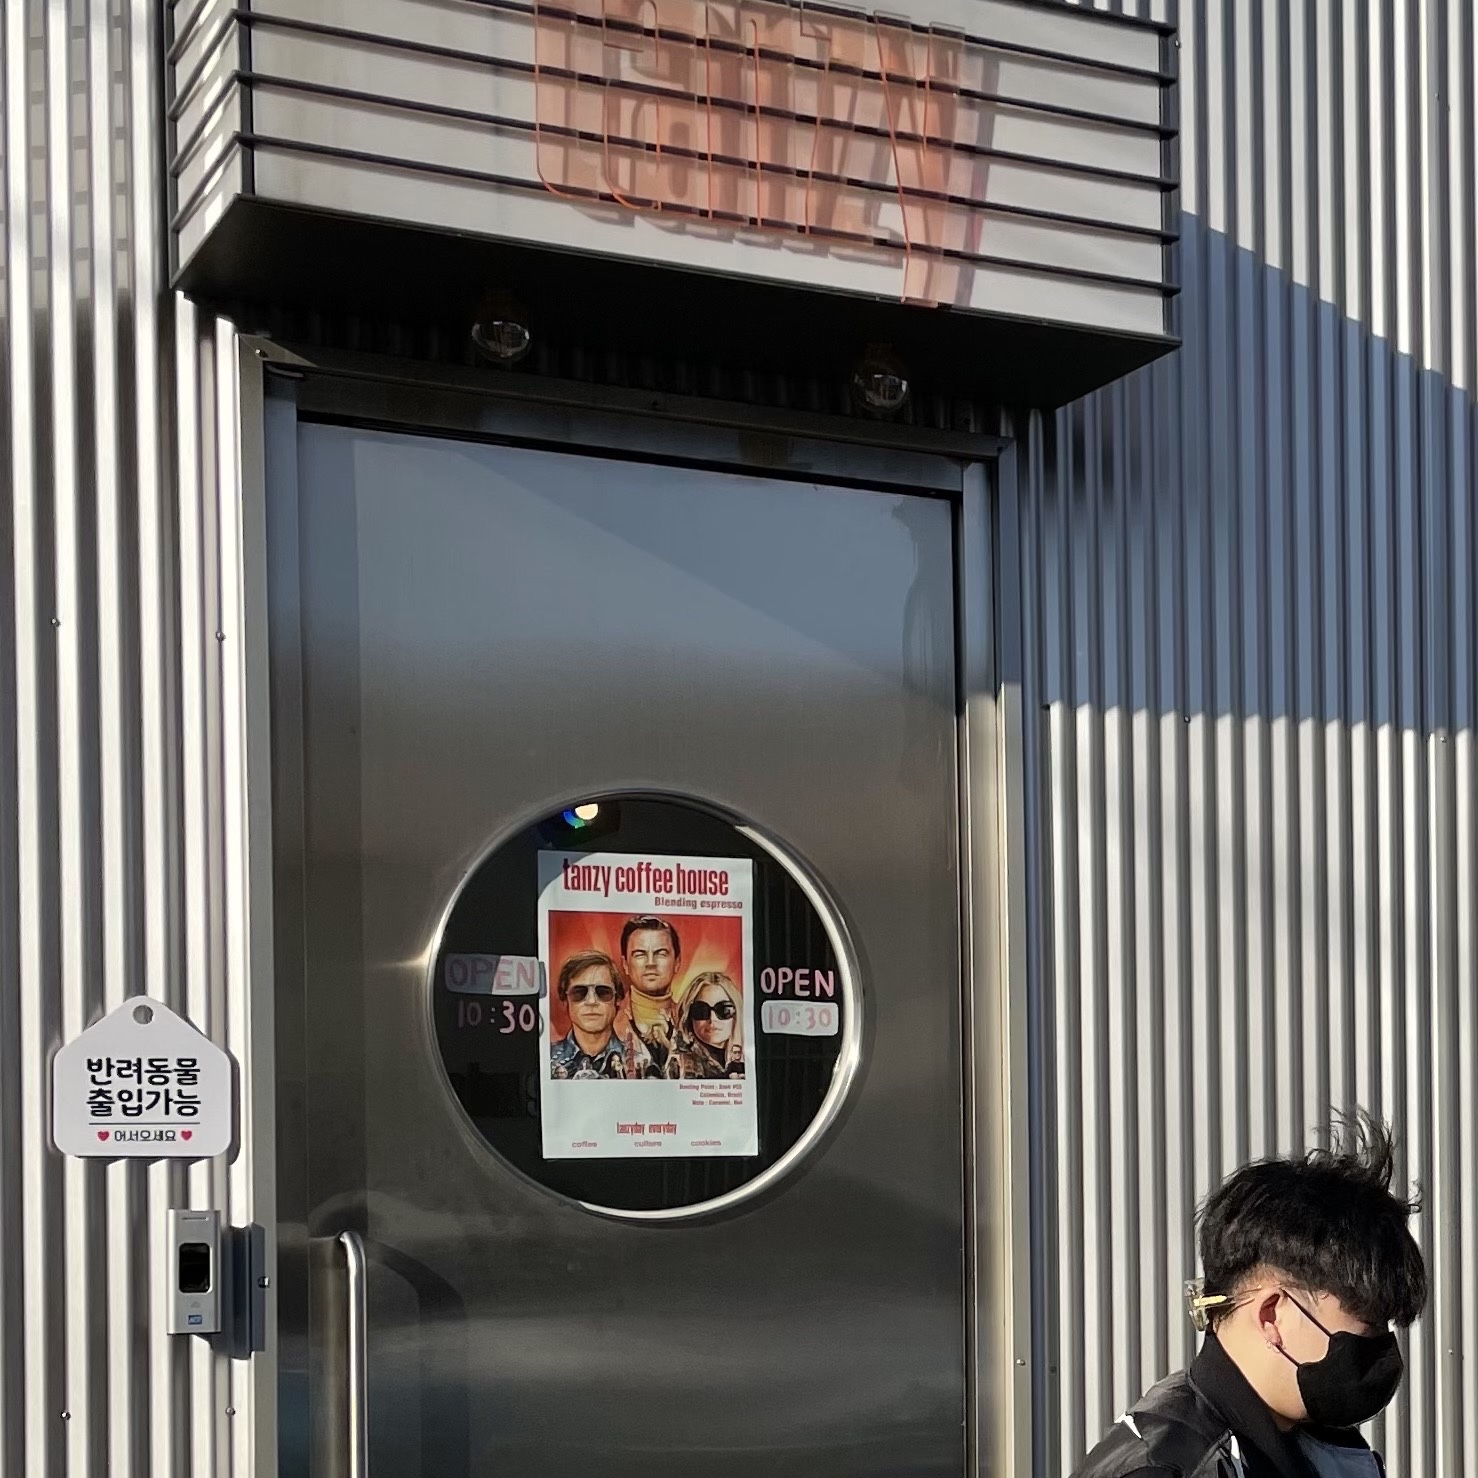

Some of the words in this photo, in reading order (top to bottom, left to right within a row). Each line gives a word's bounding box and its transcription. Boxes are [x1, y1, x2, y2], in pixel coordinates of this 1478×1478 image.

[562, 858, 612, 898] tanzy
[615, 861, 674, 894] coffee
[676, 863, 729, 896] house
[654, 896, 698, 910] Blending
[700, 899, 743, 910] espresso
[449, 957, 536, 991] OPEN
[760, 967, 835, 998] OPEN
[86, 1057, 201, 1086] 반려동물
[86, 1088, 202, 1117] 출입가능
[114, 1129, 177, 1142] 어서오세요
